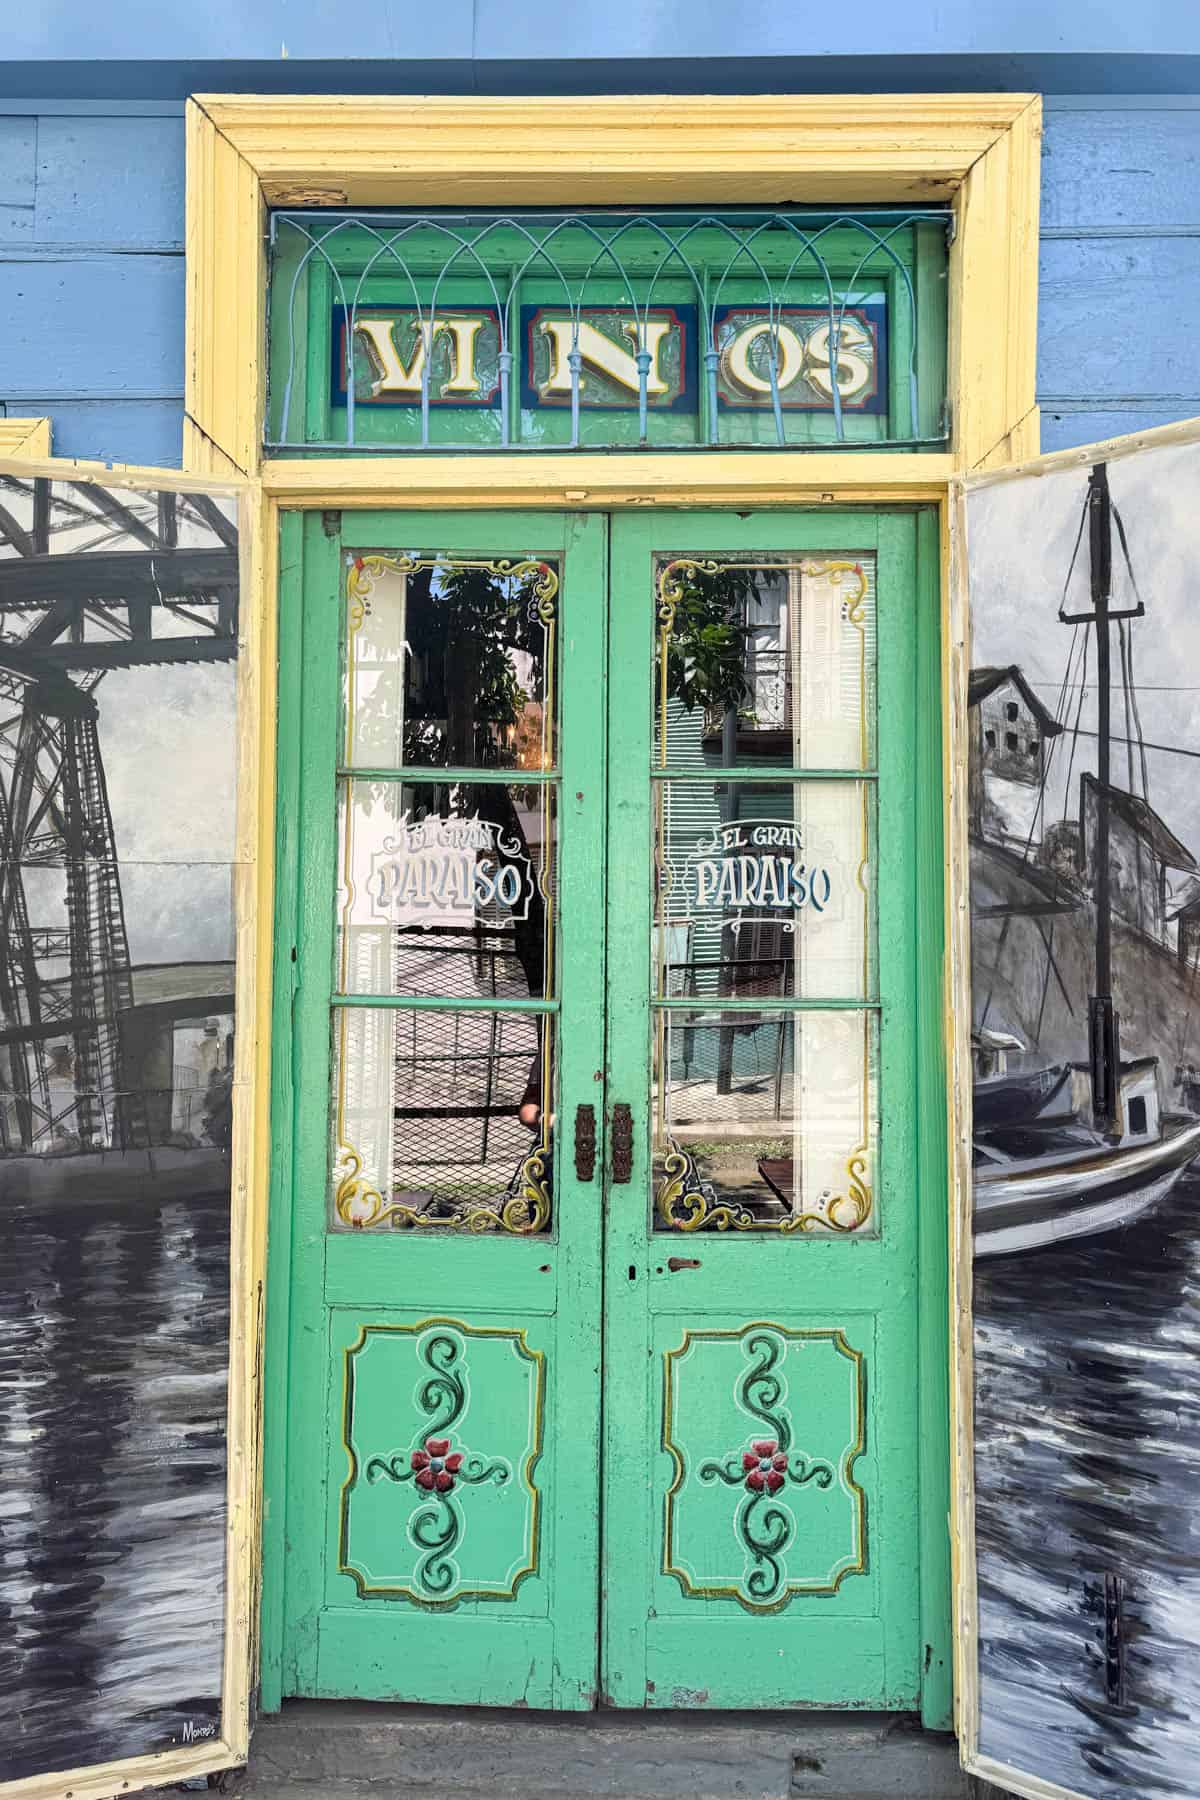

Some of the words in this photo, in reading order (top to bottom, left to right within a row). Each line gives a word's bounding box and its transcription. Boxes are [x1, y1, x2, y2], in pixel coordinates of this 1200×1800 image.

[354, 319, 869, 397] VINOS
[410, 827, 436, 852] EL
[438, 824, 494, 850] GRAN
[721, 830, 748, 850] EL
[753, 826, 804, 849] GRAN
[378, 855, 522, 909] PARAISO
[695, 855, 831, 911] PARAISO
